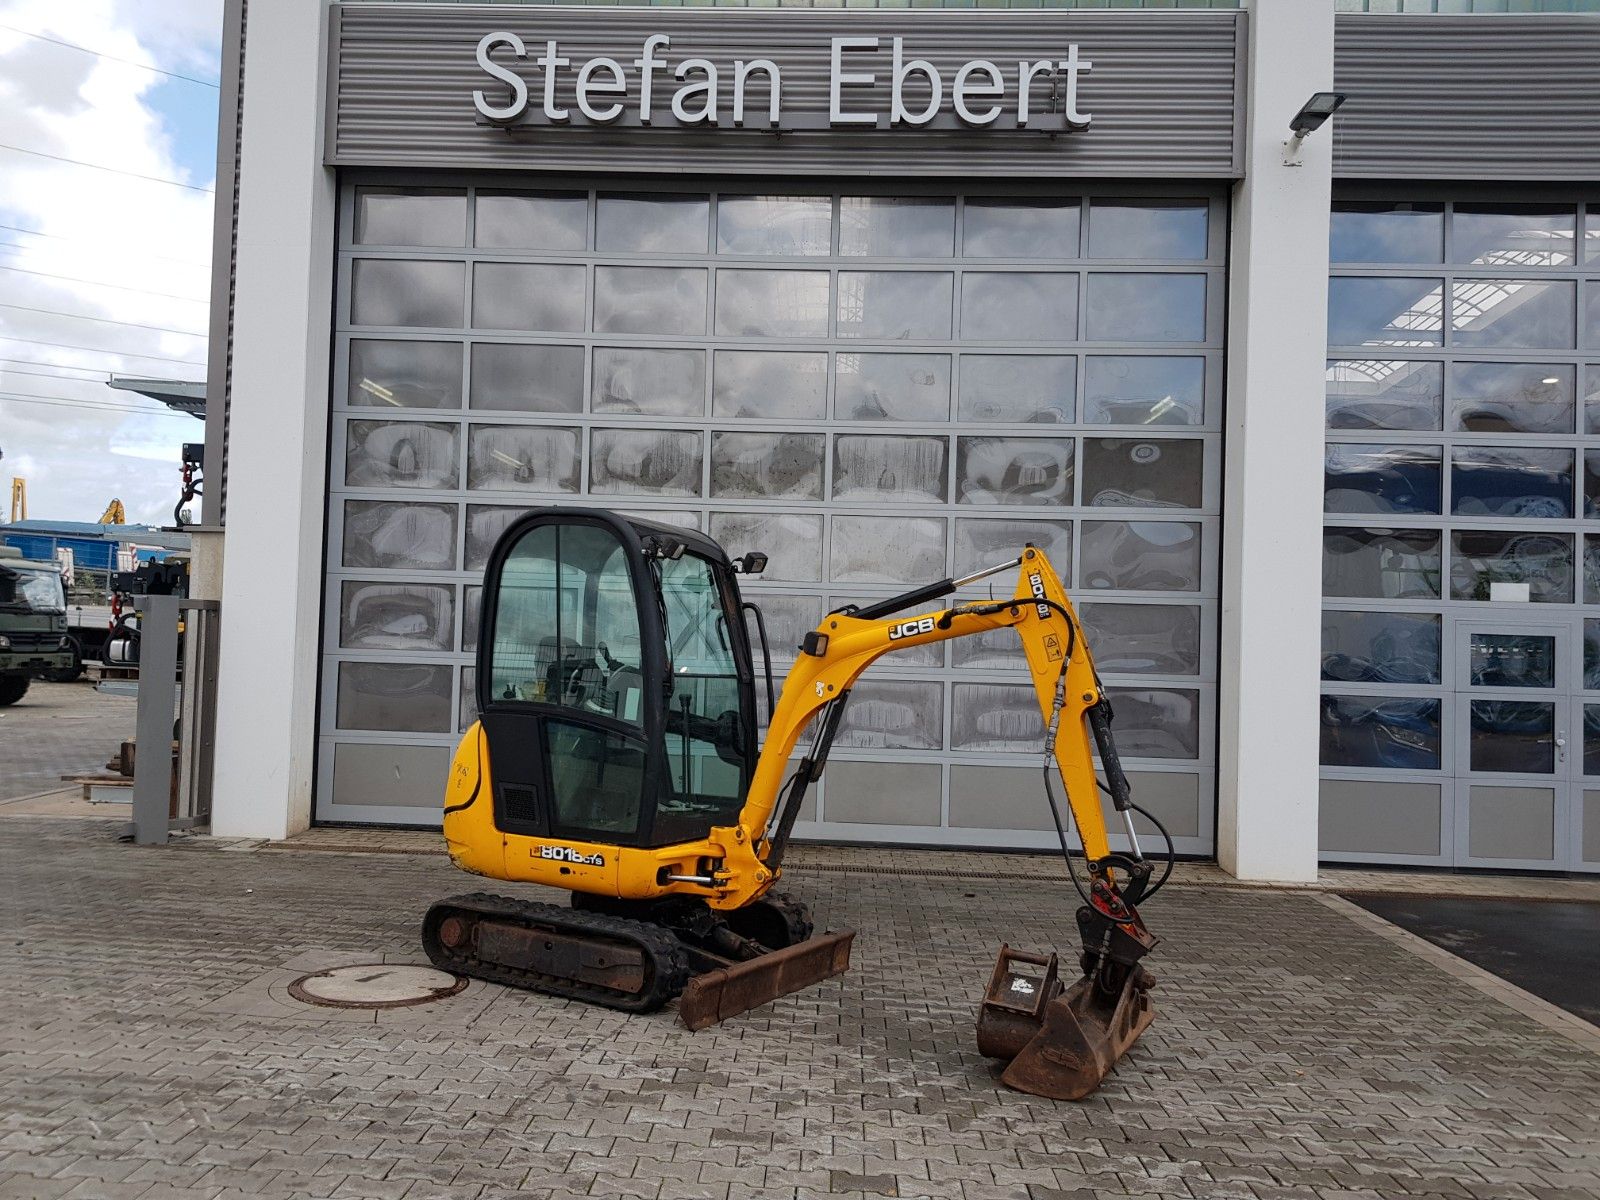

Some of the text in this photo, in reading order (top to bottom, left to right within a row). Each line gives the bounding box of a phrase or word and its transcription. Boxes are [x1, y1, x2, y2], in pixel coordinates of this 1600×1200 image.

[472, 31, 1093, 126] Stefan Ebert
[889, 617, 934, 640] JCB
